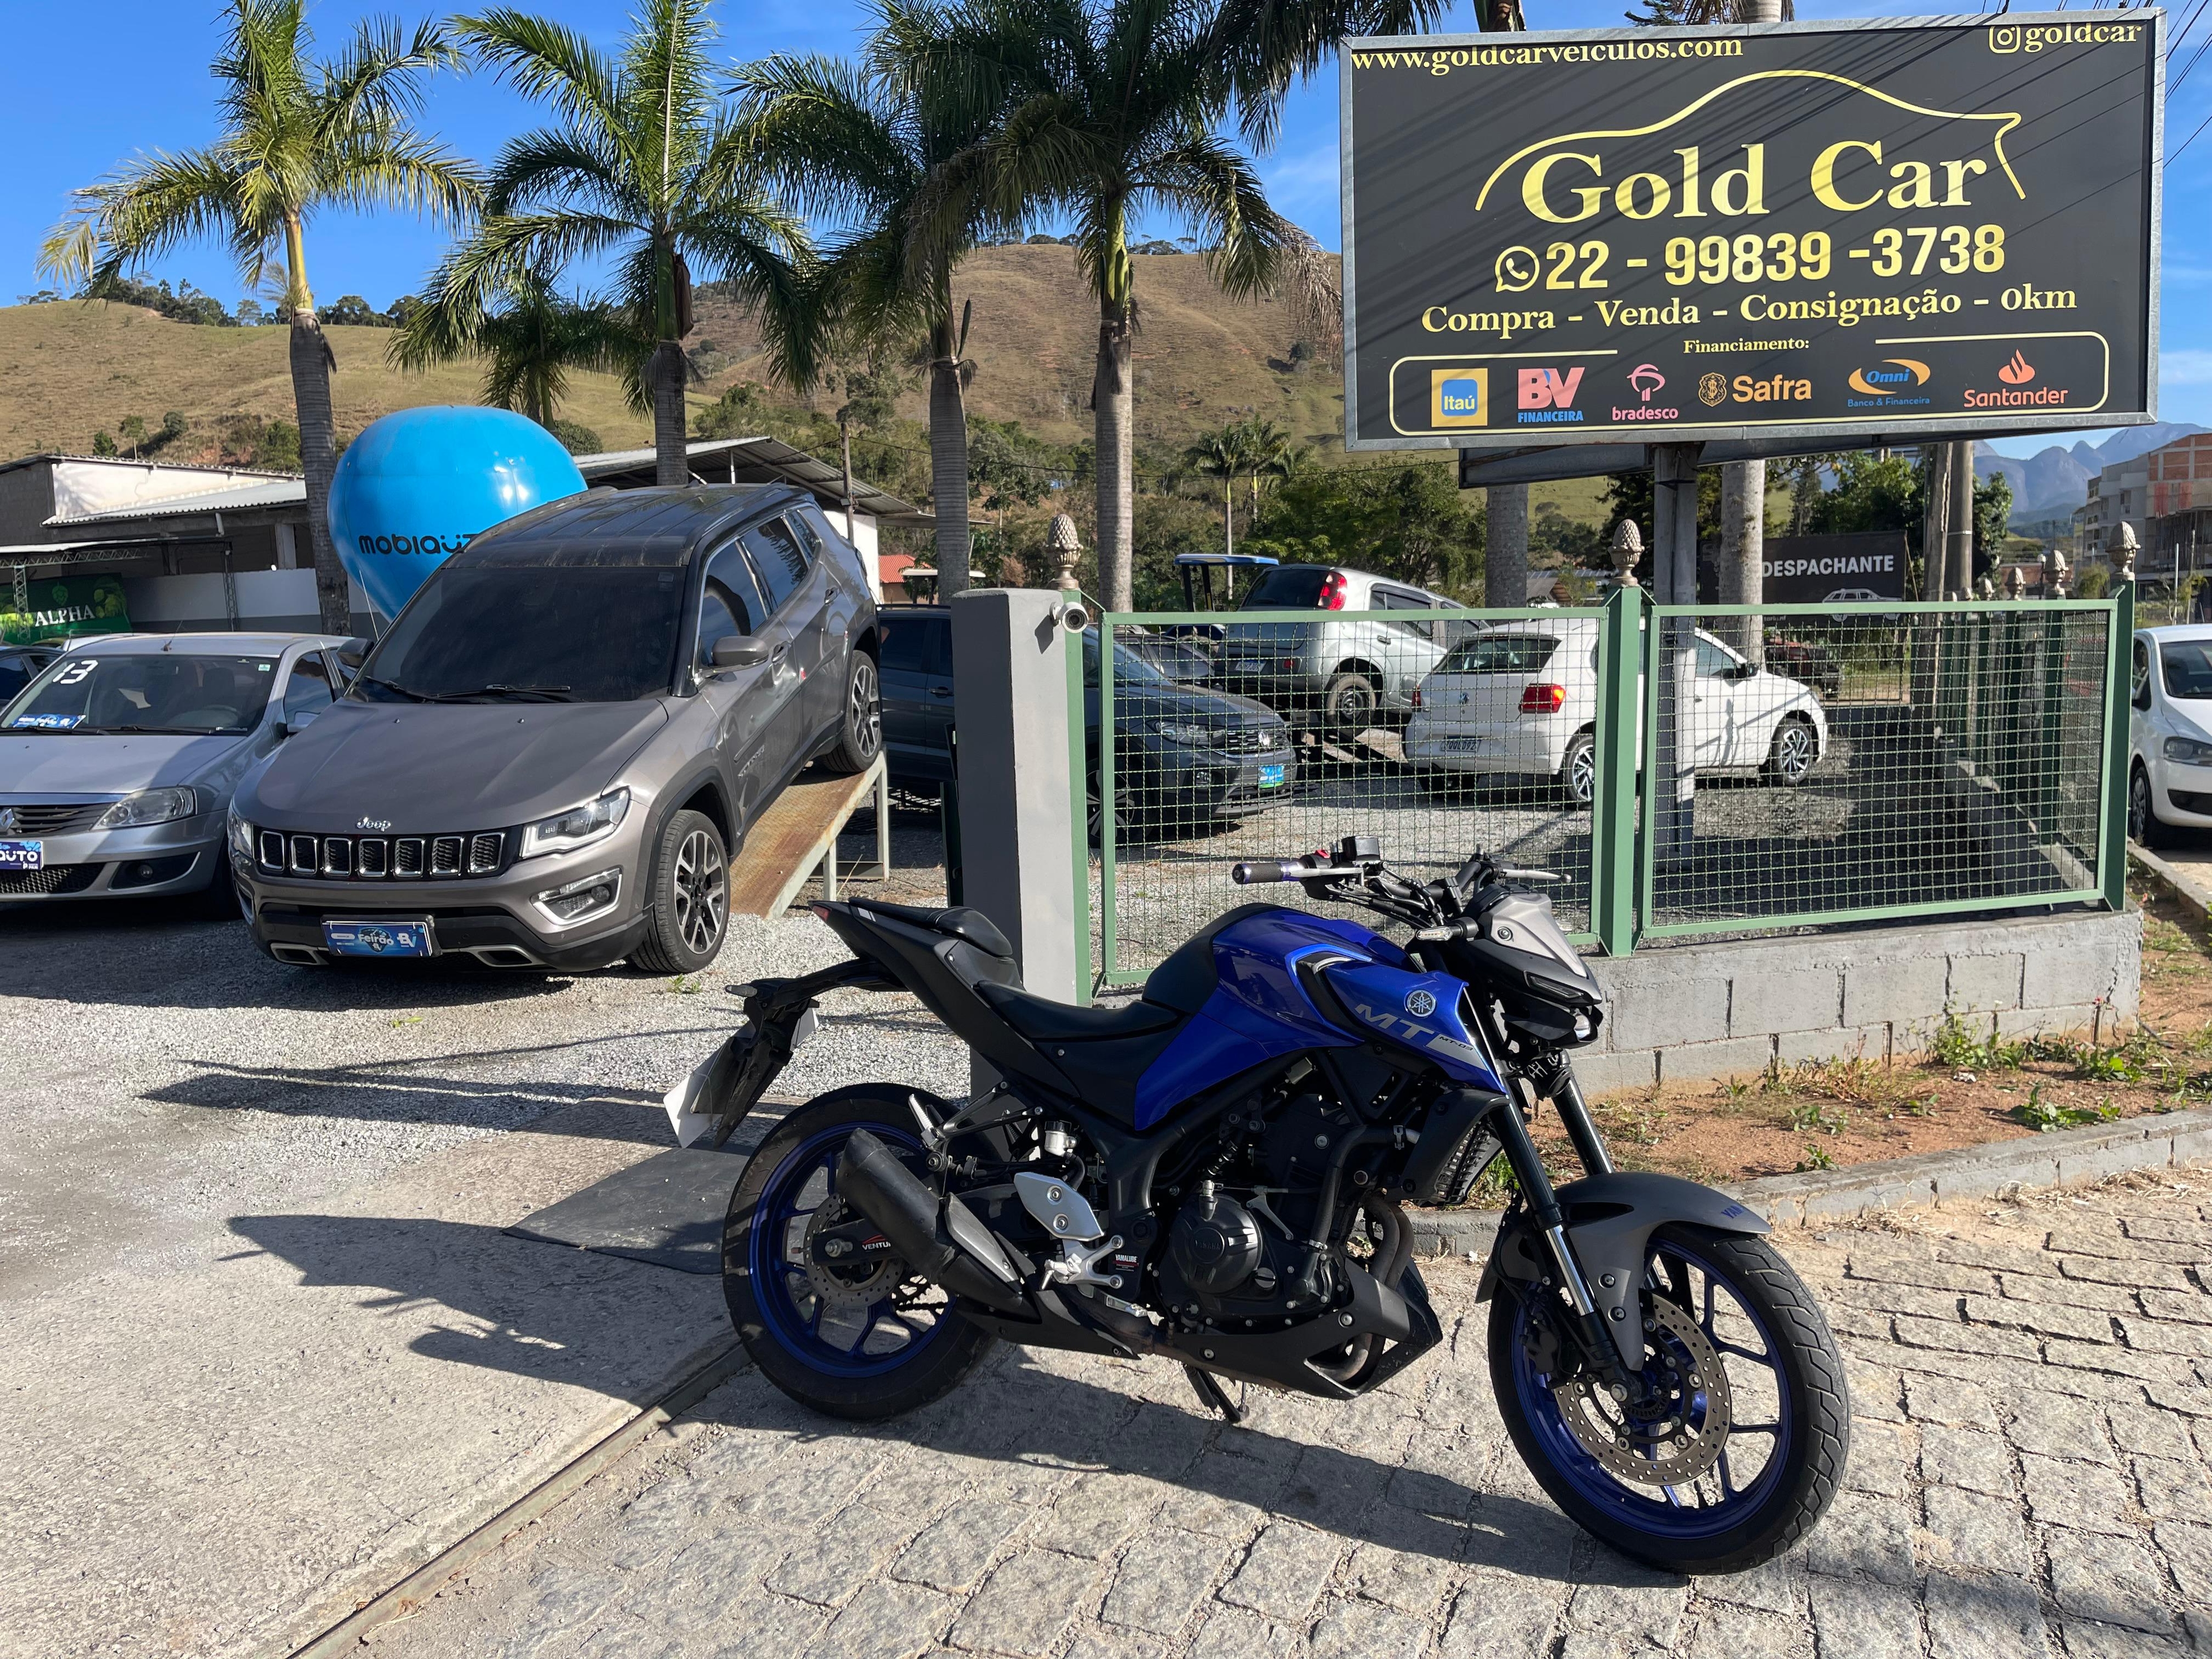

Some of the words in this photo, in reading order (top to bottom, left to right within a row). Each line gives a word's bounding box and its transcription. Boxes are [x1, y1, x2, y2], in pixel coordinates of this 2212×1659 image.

[2024, 23, 2142, 52] goldcar
[1351, 39, 1743, 76] www.goldcarveiculos.com
[1522, 143, 1770, 223] Gold
[1810, 140, 1987, 211] Car
[1546, 241, 1609, 290] 22
[1627, 258, 1647, 267] -
[1665, 232, 1831, 286] 99839
[1422, 306, 1555, 339] Compra
[1595, 297, 1700, 327] Venda
[1740, 288, 1961, 327] Consignação
[2001, 283, 2077, 310] 0km
[1684, 338, 1809, 354] Financiamento:
[1866, 368, 1911, 384] Omni
[1517, 367, 1585, 410] BV
[1732, 374, 1812, 403] Safra
[1963, 387, 2069, 408] Santander
[1444, 396, 1475, 410] Itaú
[1847, 399, 1874, 407] Banco
[1876, 397, 1883, 406] &
[1885, 396, 1930, 406] Financeira
[1517, 410, 1584, 423] FINANCEIRA
[1612, 406, 1679, 421] bradesco
[1762, 555, 1894, 578] DESPACHANTE
[35, 605, 96, 627] ALPHA
[52, 660, 99, 684] 13
[357, 816, 391, 832] Jeep
[1354, 1003, 1435, 1040] MT
[1439, 1036, 1474, 1051] MT-03
